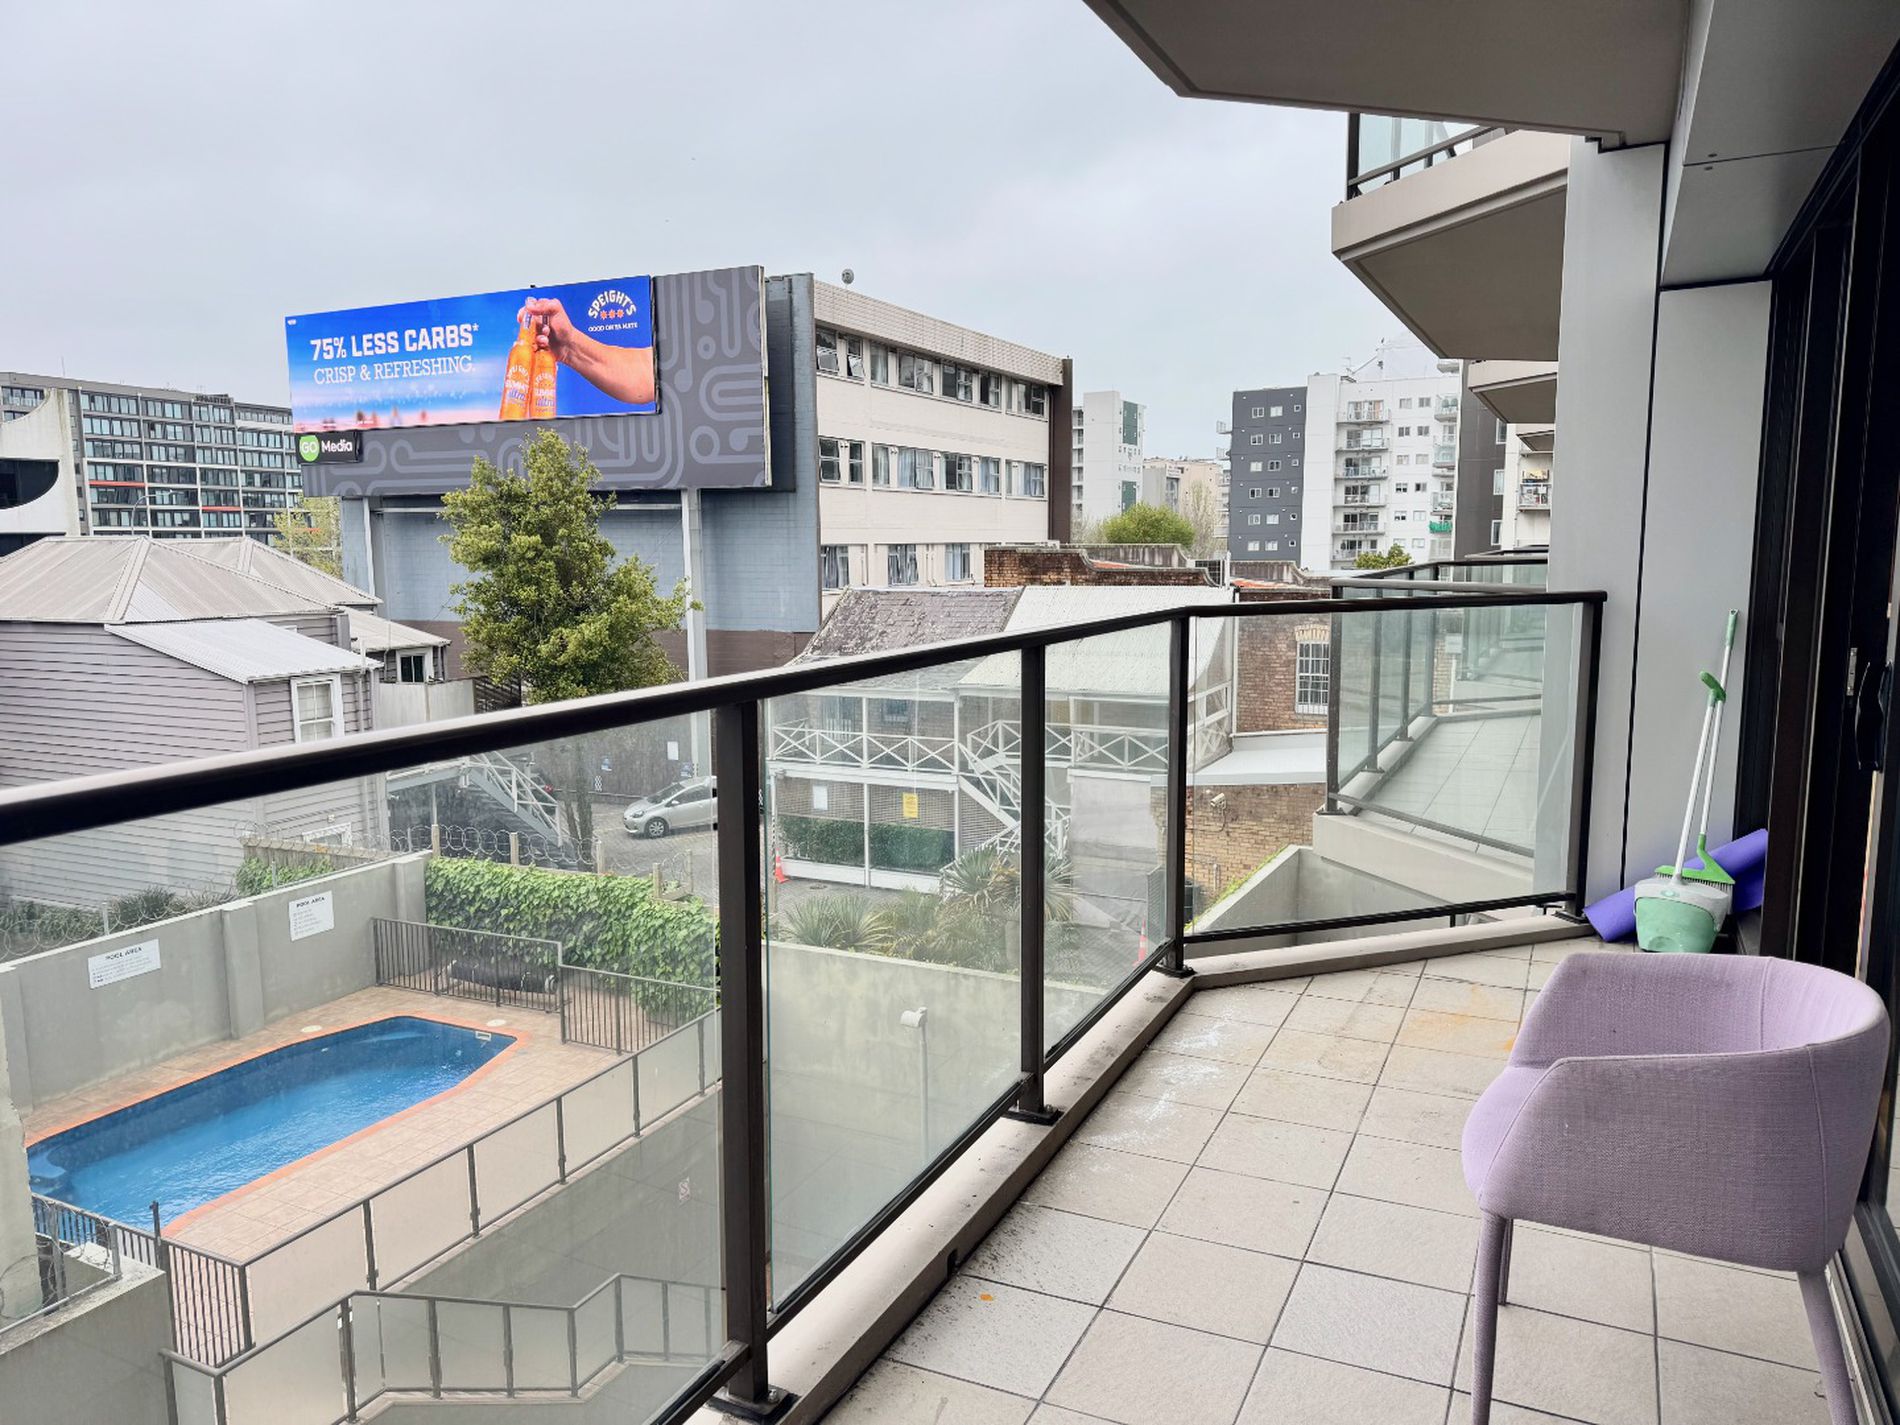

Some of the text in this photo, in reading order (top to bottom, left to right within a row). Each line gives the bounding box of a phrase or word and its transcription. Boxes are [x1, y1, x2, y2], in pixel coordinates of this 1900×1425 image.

[588, 290, 637, 318] SPEIGHT'S
[310, 336, 347, 361] 75%
[350, 331, 399, 357] LESS
[314, 355, 476, 385] CRISP & REFRESHING.
[301, 439, 353, 454] GO Media
